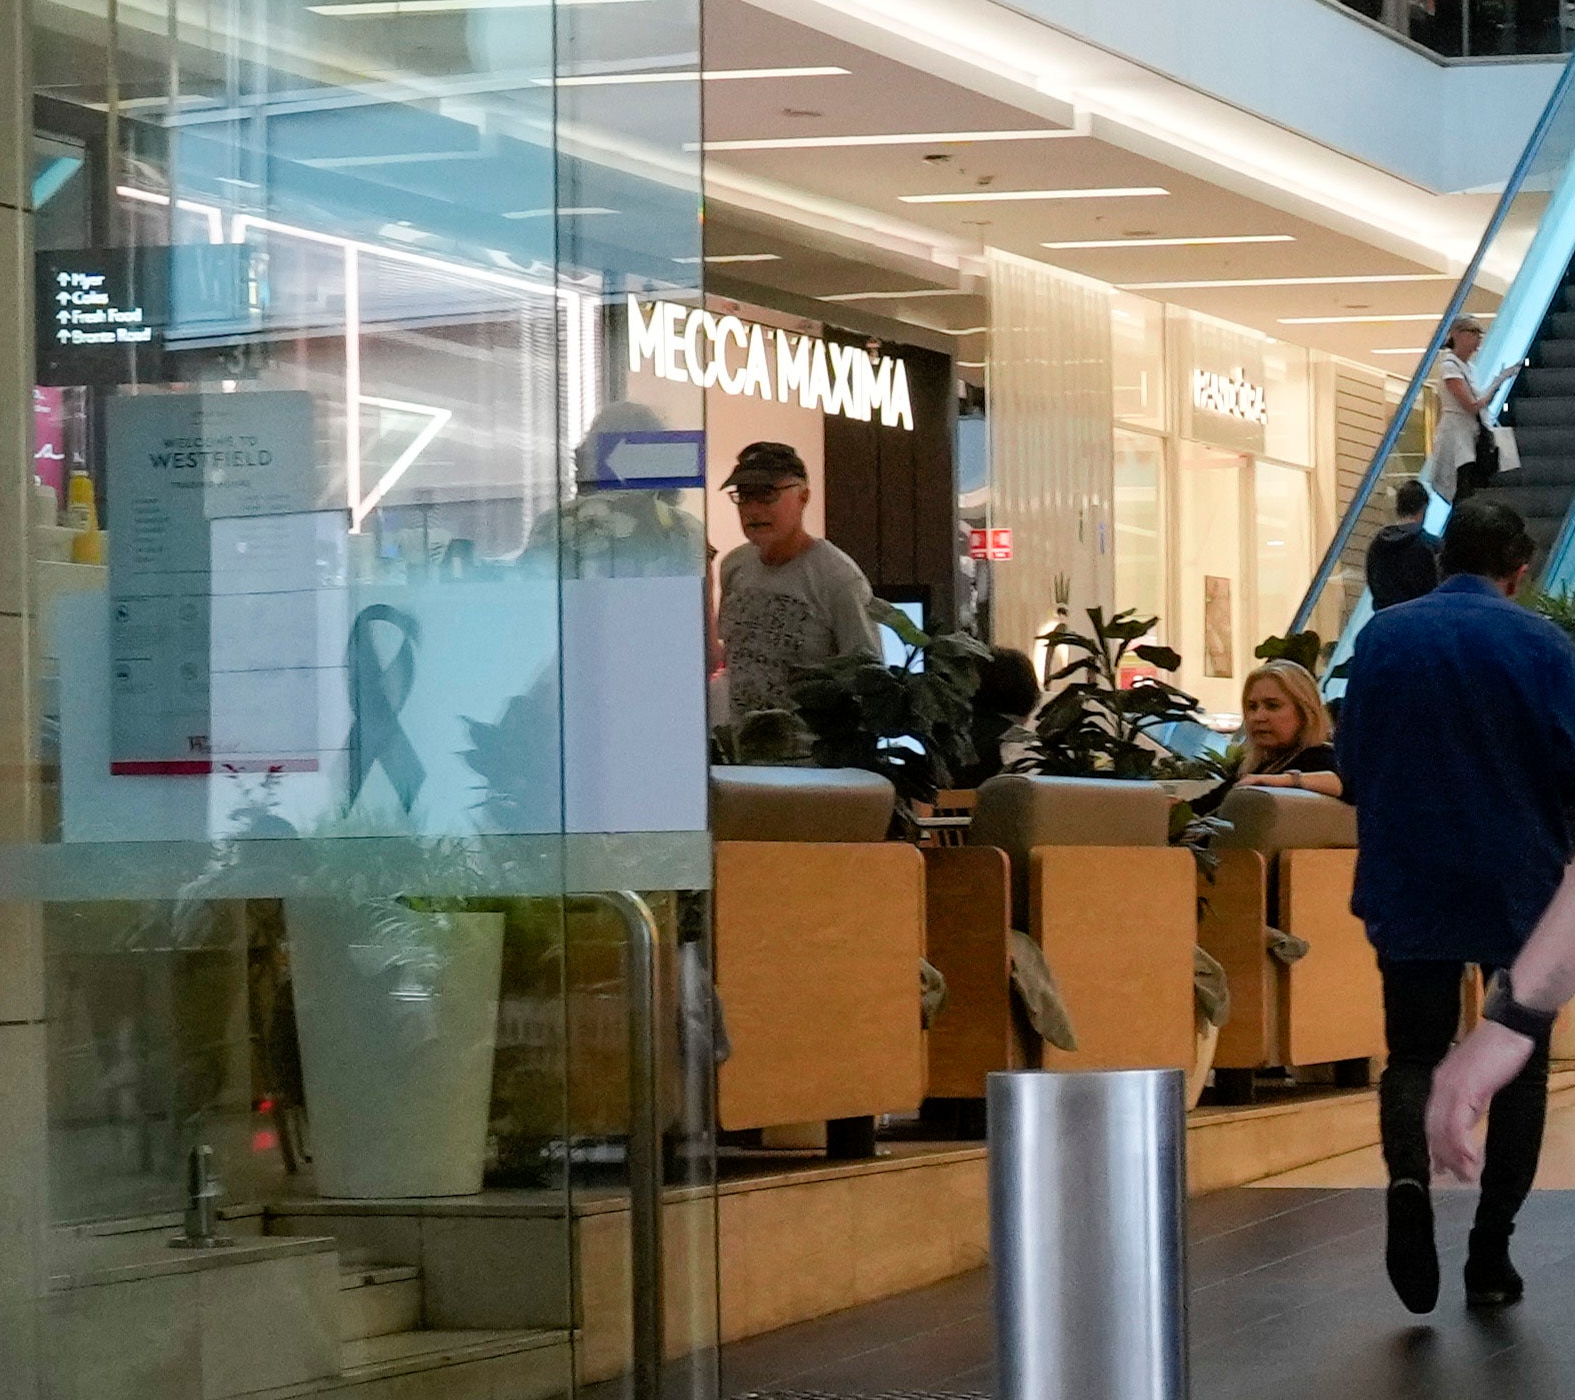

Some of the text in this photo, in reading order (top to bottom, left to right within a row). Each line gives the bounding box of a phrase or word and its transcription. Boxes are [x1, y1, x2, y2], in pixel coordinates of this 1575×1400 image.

[71, 273, 106, 291] Myer
[108, 308, 143, 323] Food
[628, 294, 914, 430] MECCA MAXIMA
[149, 449, 273, 469] WESTFIELD
